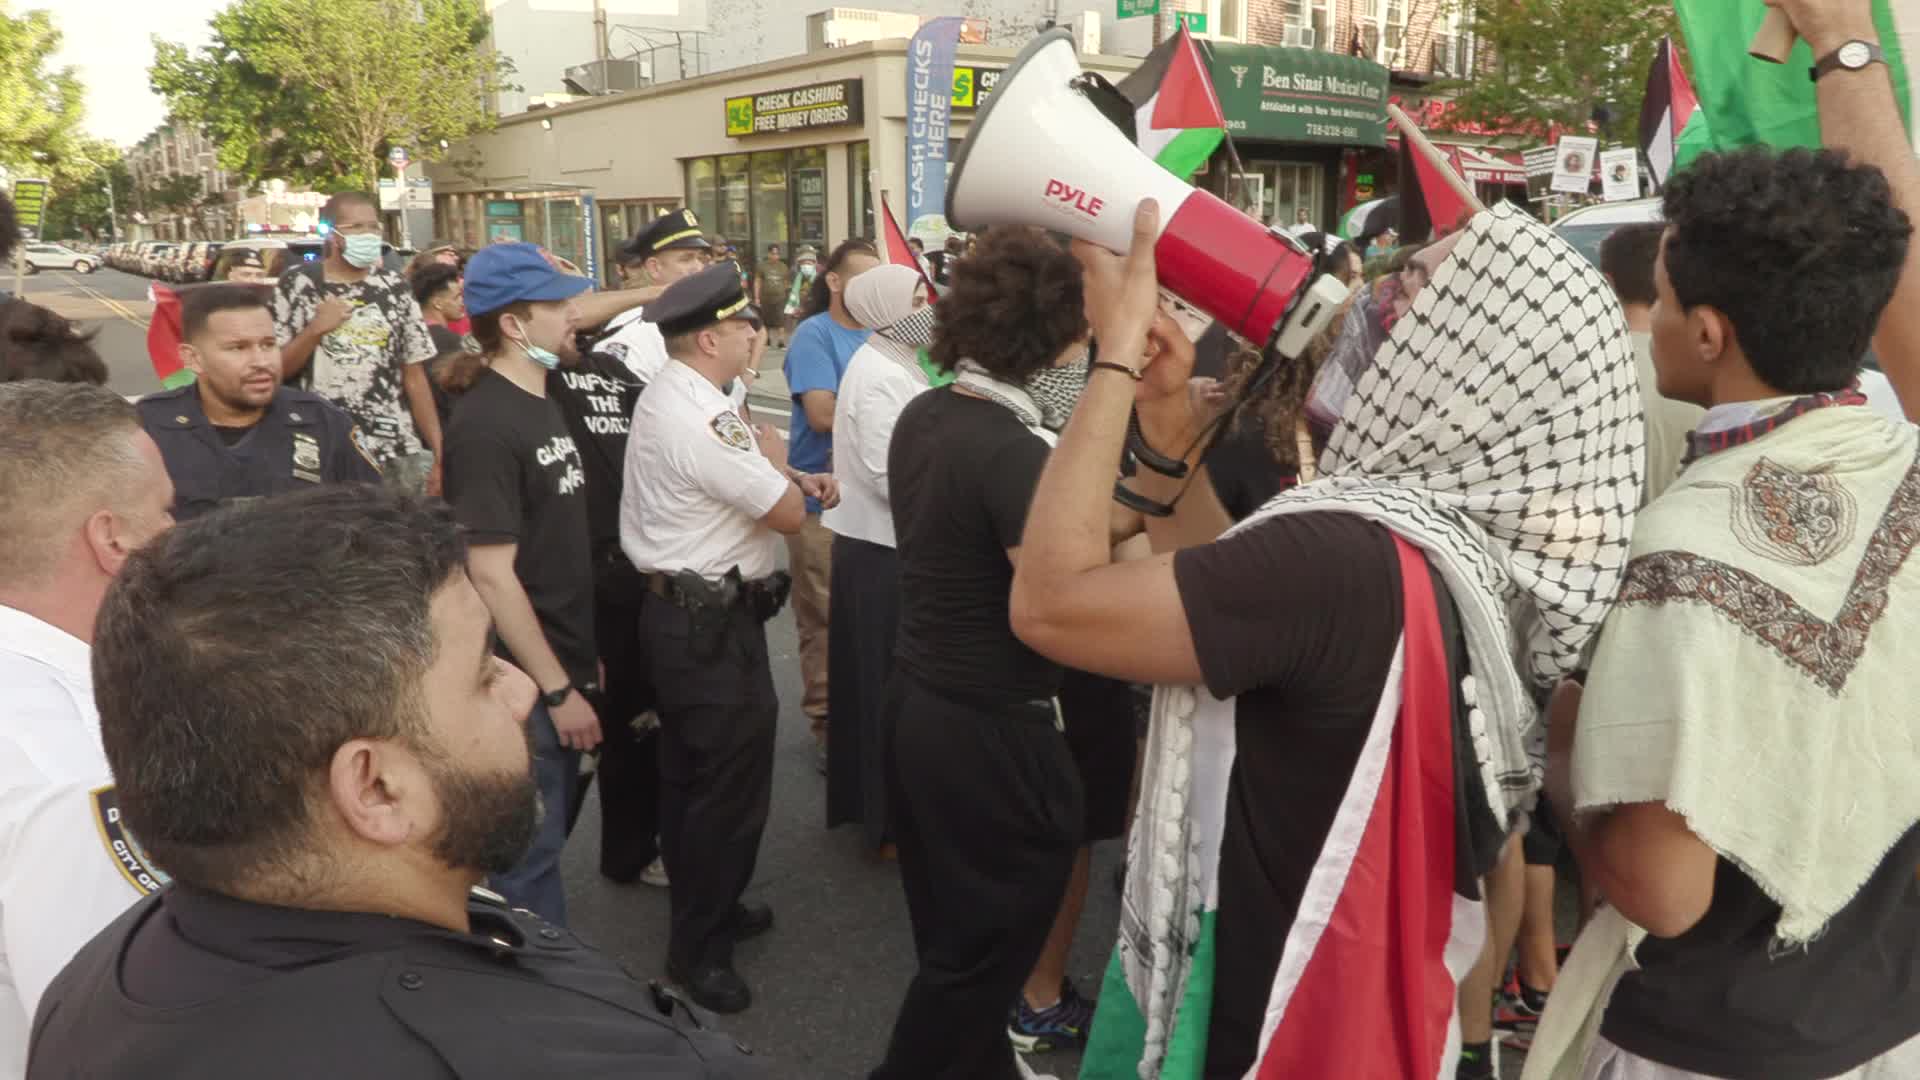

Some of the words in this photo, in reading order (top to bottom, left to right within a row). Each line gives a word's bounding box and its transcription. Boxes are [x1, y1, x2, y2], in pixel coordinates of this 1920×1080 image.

[912, 40, 932, 138] CHECKS
[1263, 65, 1290, 89] Ben
[1293, 73, 1322, 92] Sinai
[756, 92, 791, 112] CHECK
[793, 84, 844, 106] CASHING
[755, 113, 776, 131] FREE
[777, 111, 808, 129] MONEY
[810, 105, 848, 125] ORDERS
[927, 94, 946, 159] HERE
[912, 143, 925, 208] CASH
[587, 395, 622, 413] THE
[113, 839, 142, 872] CITY
